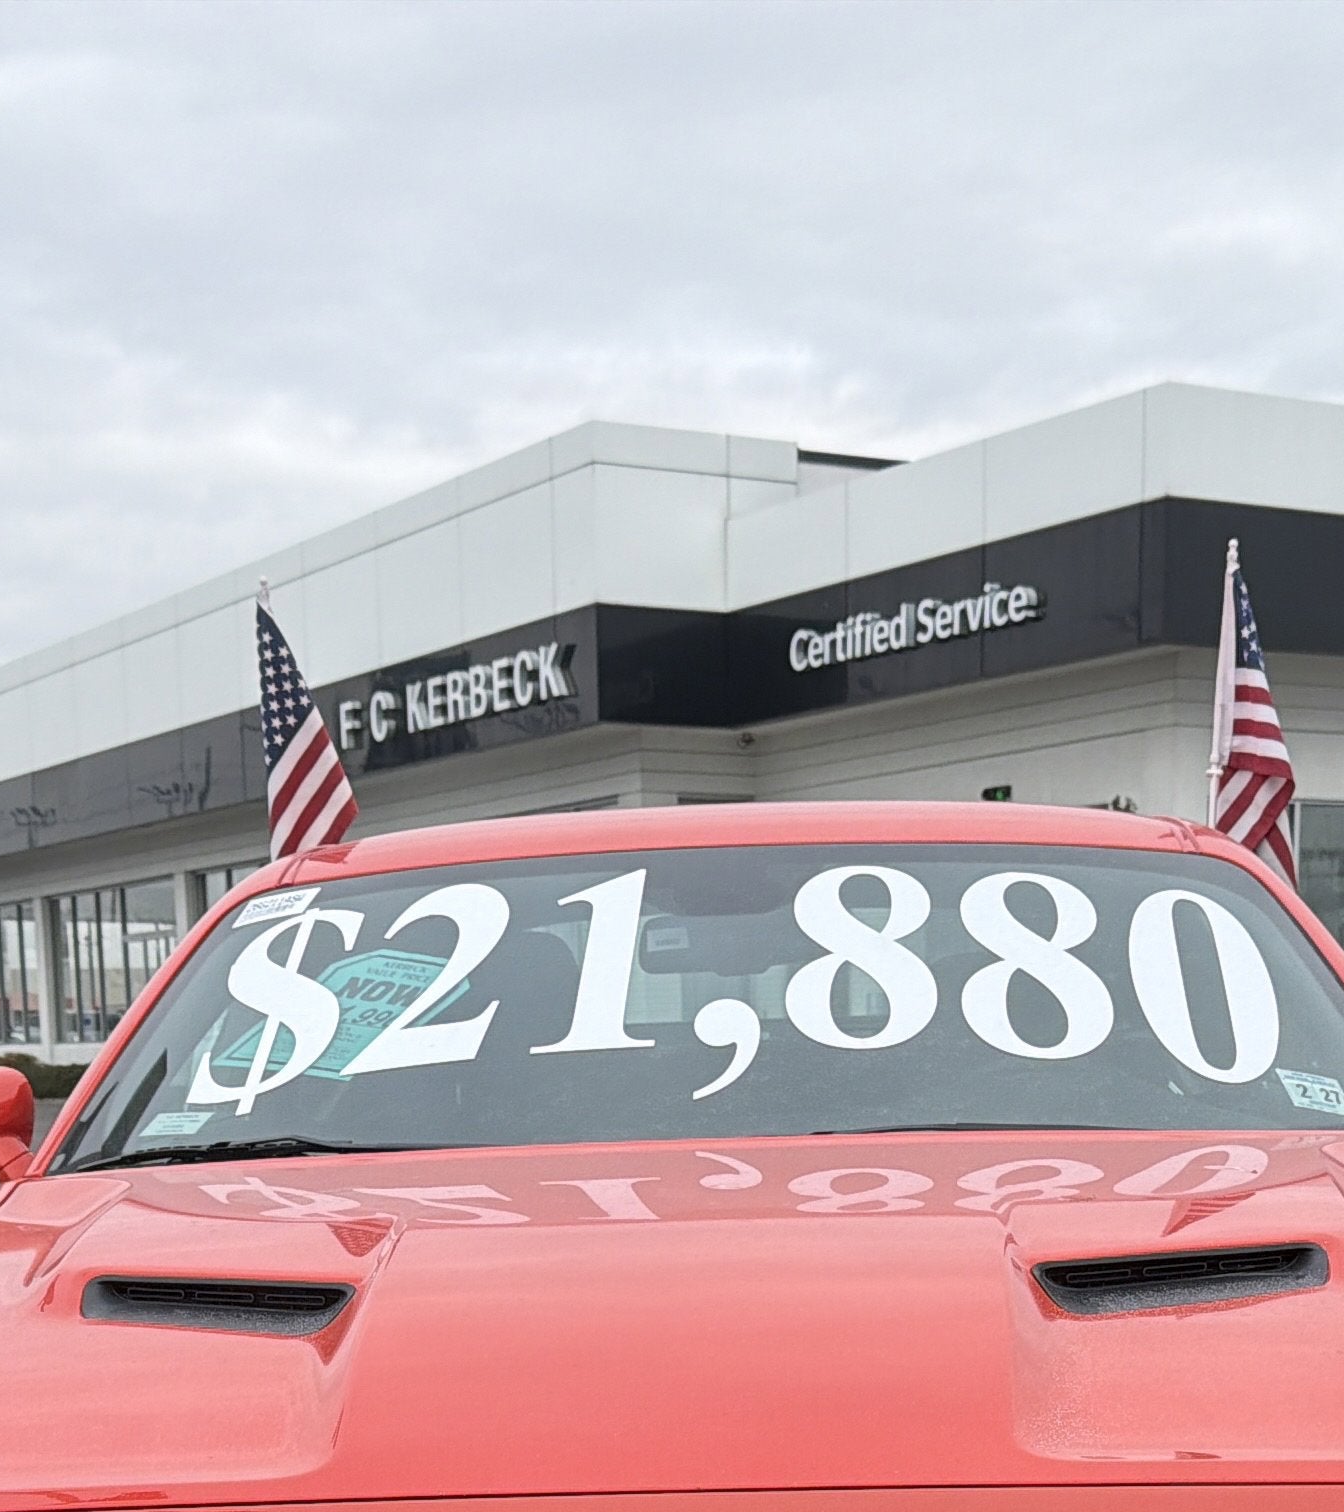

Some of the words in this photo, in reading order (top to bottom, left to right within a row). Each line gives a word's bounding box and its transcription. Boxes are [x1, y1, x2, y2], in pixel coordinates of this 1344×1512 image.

[790, 602, 914, 672] Certified
[916, 581, 1039, 643] Service
[339, 700, 362, 750] F
[369, 690, 396, 743] C
[406, 642, 572, 734] KERBECK
[185, 865, 1280, 1117] $21,880
[1296, 1083, 1312, 1099] 2
[1319, 1088, 1341, 1104] 27
